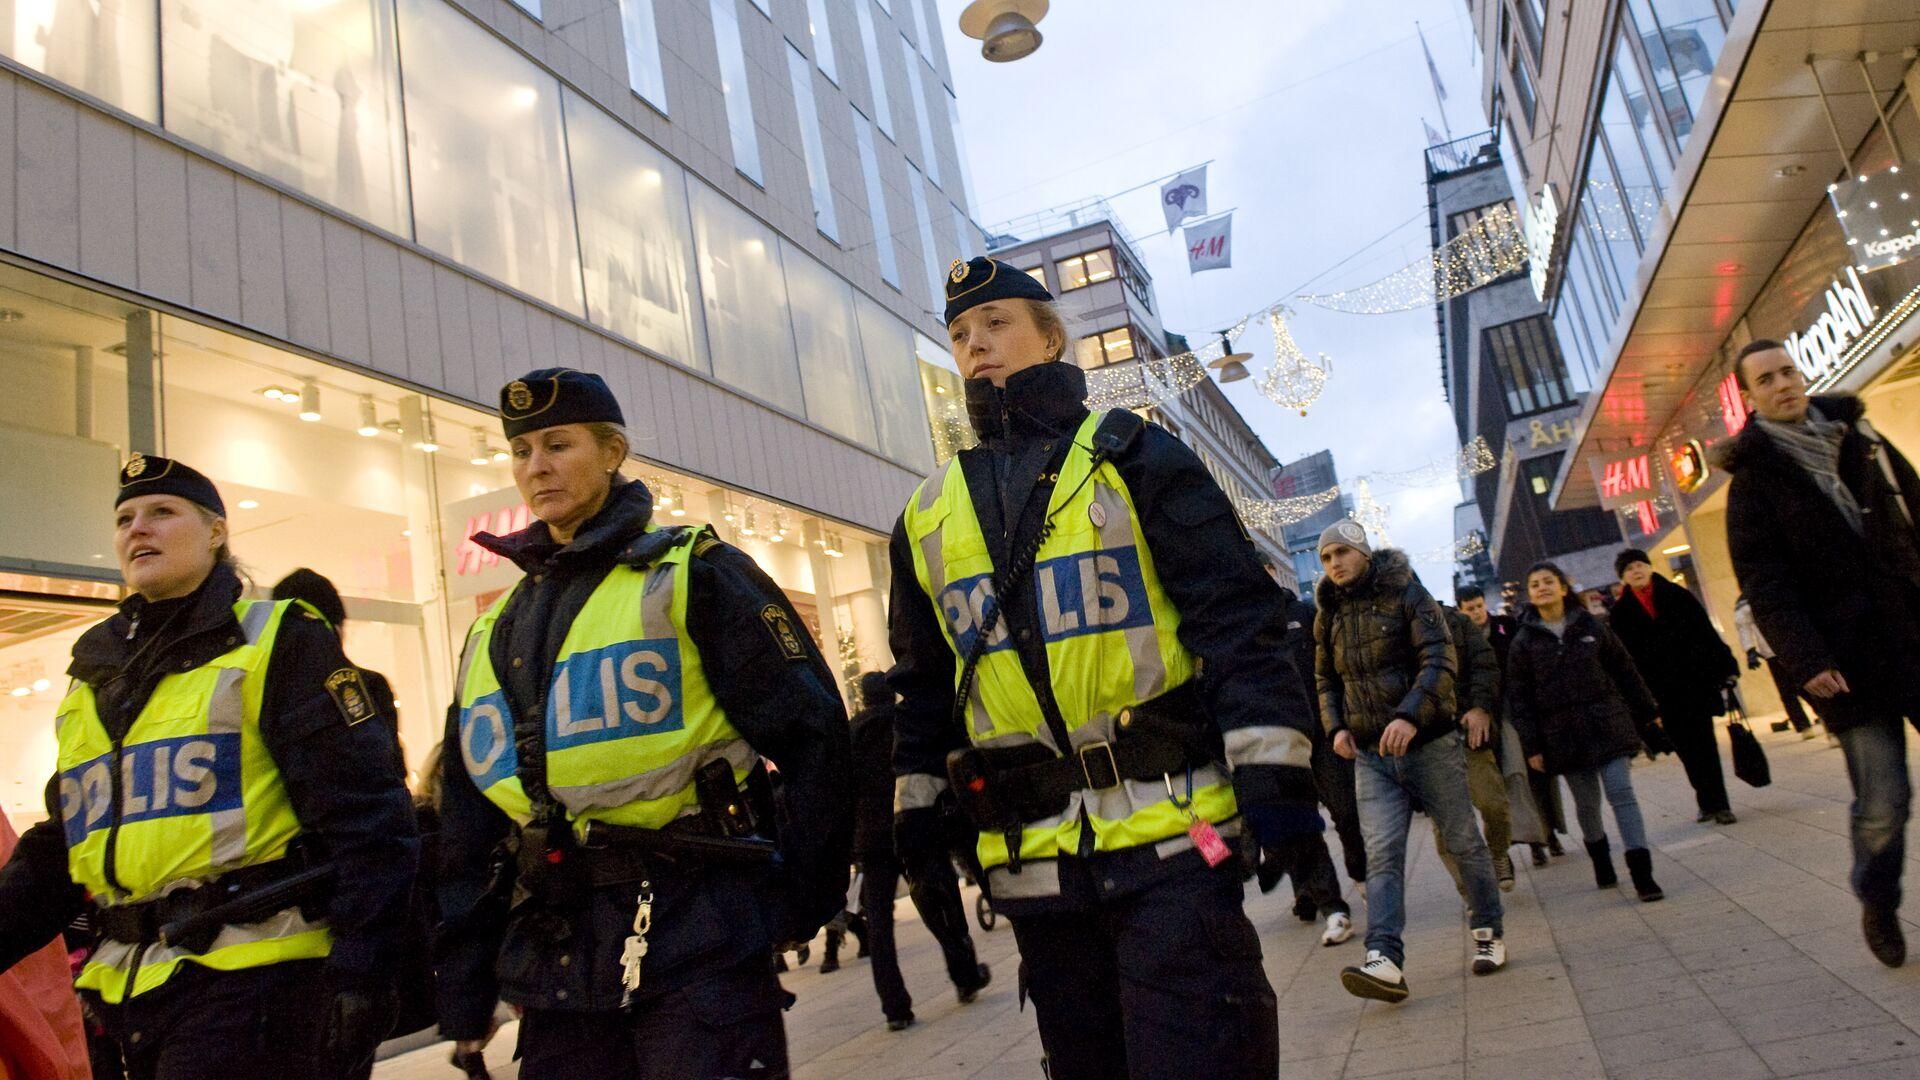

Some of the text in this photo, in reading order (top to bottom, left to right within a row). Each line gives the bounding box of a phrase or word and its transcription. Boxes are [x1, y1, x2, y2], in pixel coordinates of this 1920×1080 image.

[1784, 265, 1876, 381] KappAhl
[1530, 420, 1578, 449] ÅH
[1601, 454, 1651, 498] H&M
[461, 650, 672, 776] OLIS
[60, 740, 217, 828] POLIS
